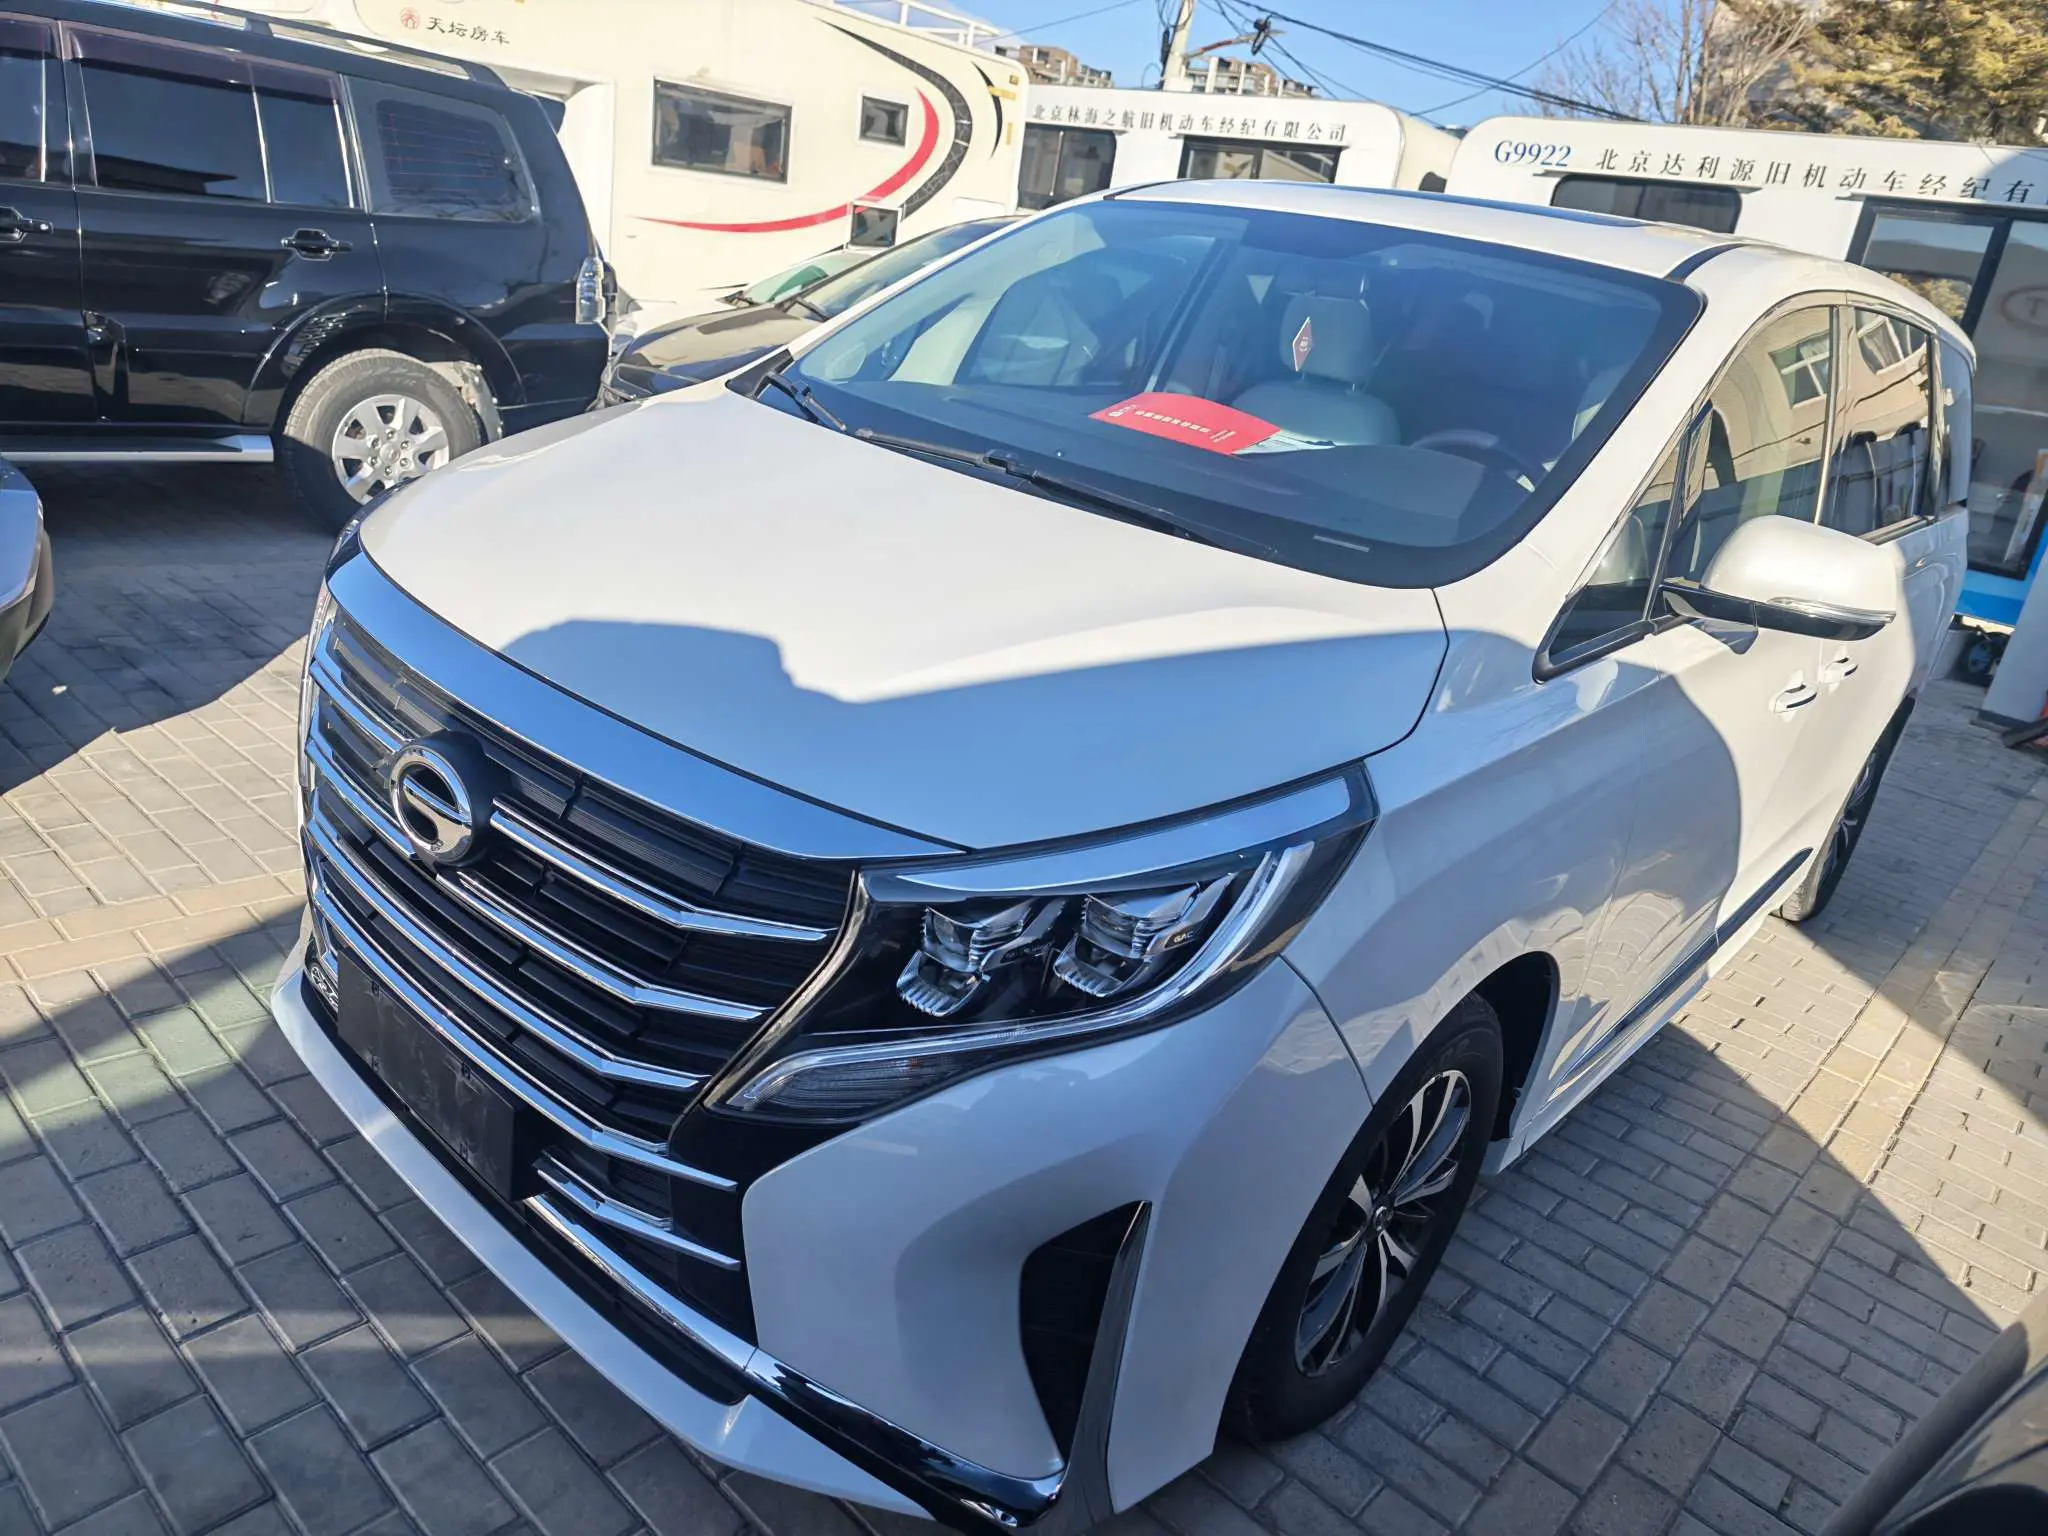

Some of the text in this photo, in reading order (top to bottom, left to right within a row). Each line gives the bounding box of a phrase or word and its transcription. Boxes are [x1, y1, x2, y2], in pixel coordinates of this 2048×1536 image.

[426, 16, 510, 44] 天坛房车
[1494, 140, 1572, 167] G9922
[1596, 148, 2048, 205] 北京达利源旧机动车经纪有
